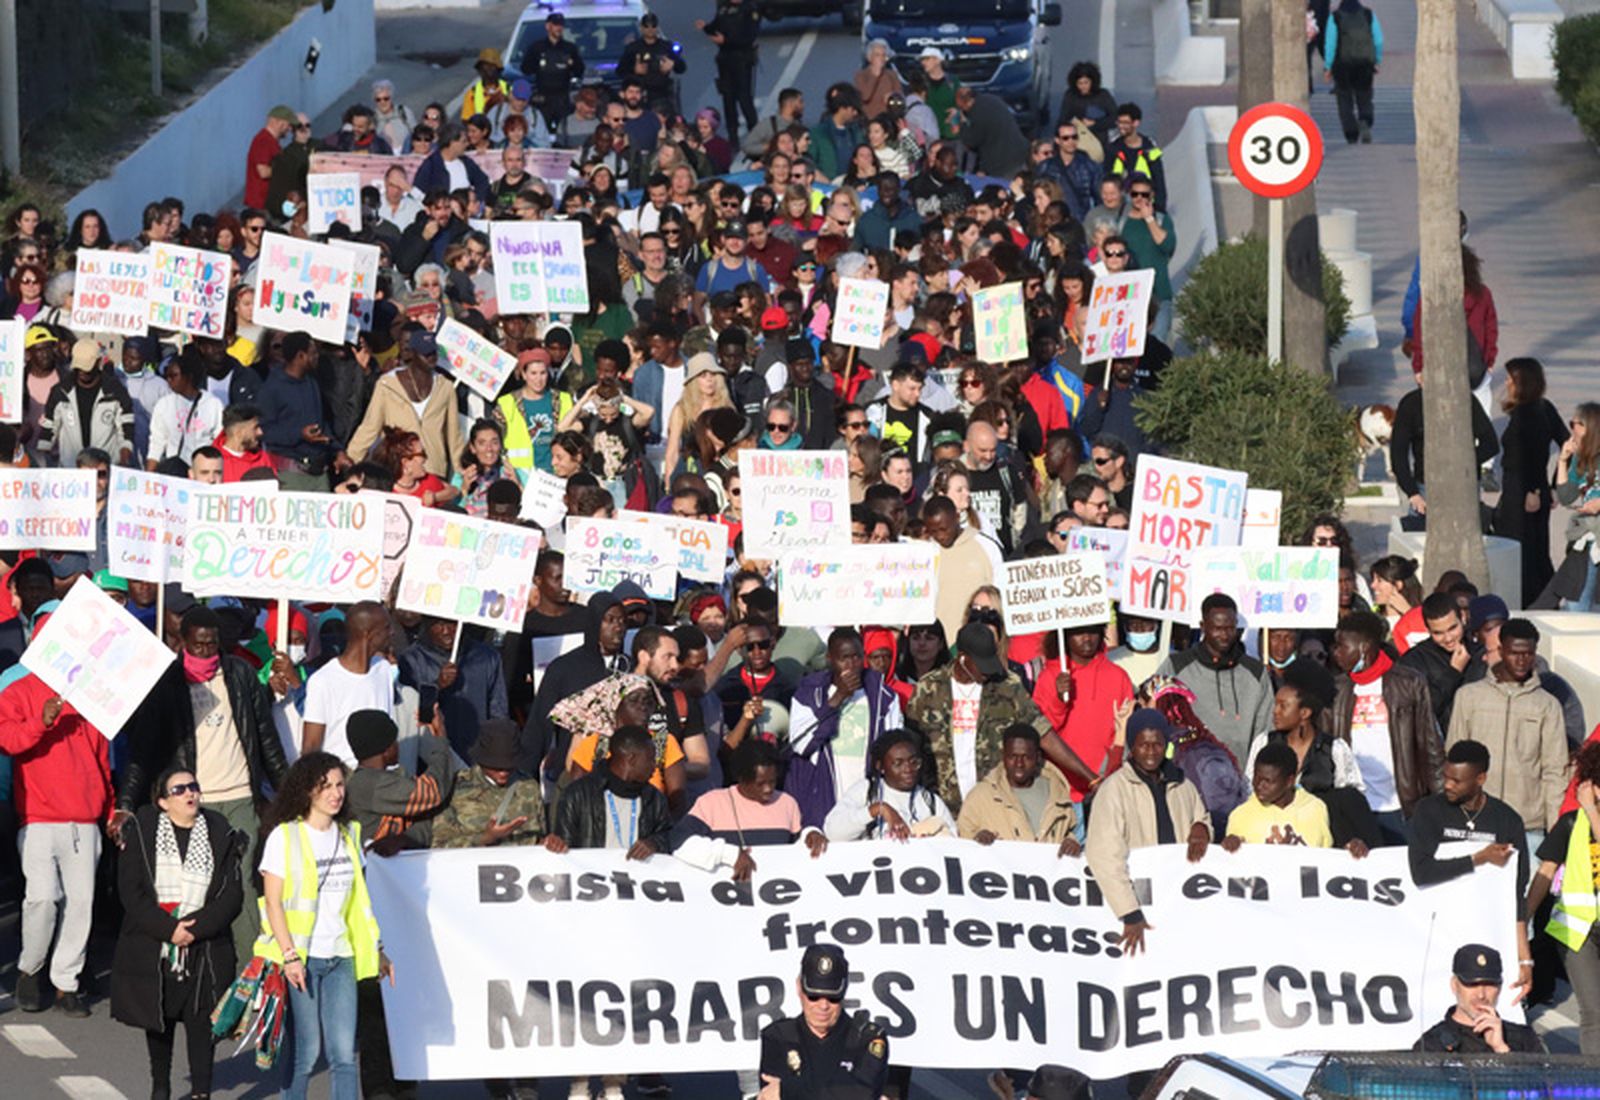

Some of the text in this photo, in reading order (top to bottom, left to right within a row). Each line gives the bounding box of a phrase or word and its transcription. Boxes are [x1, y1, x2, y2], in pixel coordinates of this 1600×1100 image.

[907, 37, 970, 47] POLICIA
[1250, 135, 1301, 166] 30
[79, 260, 148, 279] LAS LEYES
[79, 292, 111, 309] NO
[173, 290, 190, 304] EN
[145, 480, 168, 497] LEY
[1143, 468, 1241, 520] BASTA
[194, 494, 367, 530] TENEMOS DERECHO
[775, 510, 798, 527] ES
[115, 522, 157, 542] MATA
[236, 527, 309, 542] A TENER
[584, 527, 642, 550] 8 años
[192, 531, 380, 589] Derechos
[600, 551, 659, 567] pidiendo
[789, 558, 842, 578] Migrar
[585, 569, 653, 588] JUSTICIA
[1007, 559, 1083, 585] ITINÉRAIRES
[863, 579, 930, 606] Igualdad
[1006, 585, 1049, 606] LÉGAUX
[1062, 574, 1103, 598] SÛRS
[1129, 565, 1192, 613] MAR
[1011, 613, 1035, 625] POUR
[1037, 608, 1052, 622] LES
[478, 864, 685, 903] Basta
[711, 877, 802, 906] de
[1181, 872, 1269, 901] en
[1300, 865, 1406, 906] las
[487, 976, 786, 1050] MIGRAR
[952, 974, 1047, 1045] UN
[1077, 965, 1414, 1053] DERECHO
